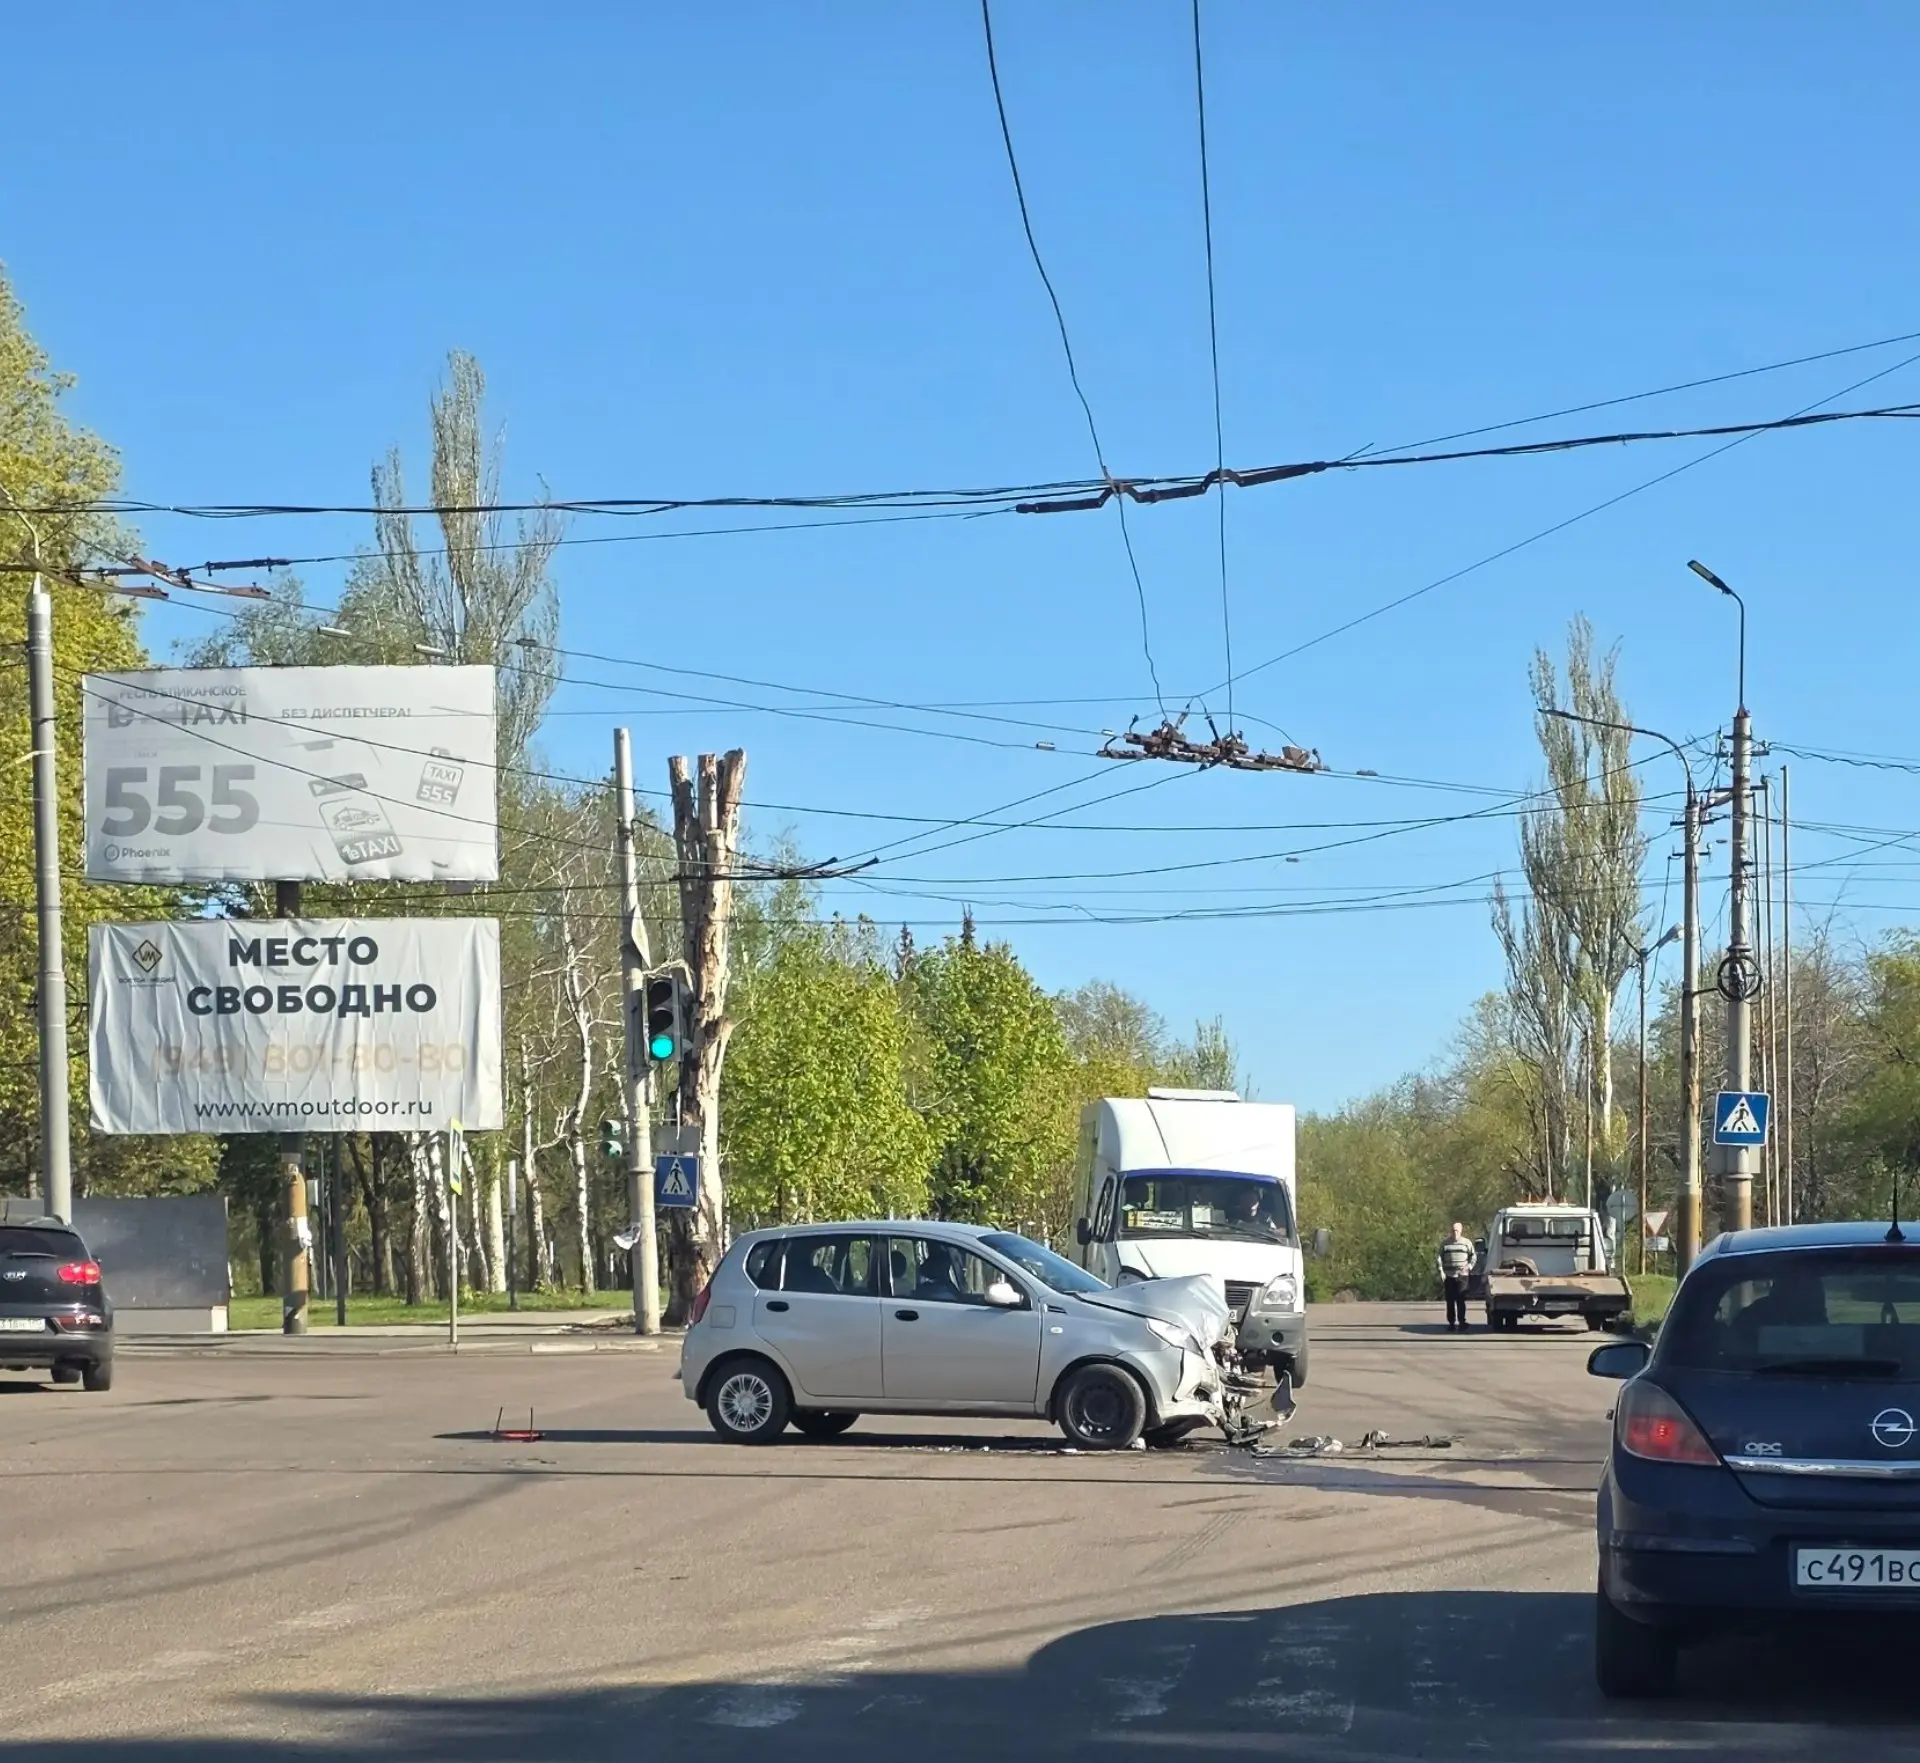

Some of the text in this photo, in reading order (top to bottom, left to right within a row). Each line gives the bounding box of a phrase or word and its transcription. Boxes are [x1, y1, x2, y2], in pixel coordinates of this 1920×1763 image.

[281, 708, 308, 719] БЕЗ
[430, 766, 457, 784] TAXI
[101, 764, 260, 837] 555
[121, 847, 171, 858] Phoenix
[229, 936, 379, 967] МЕСТО
[186, 983, 437, 1018] СВОБОДНО
[194, 1098, 433, 1117] www.vmoutdoor.ru
